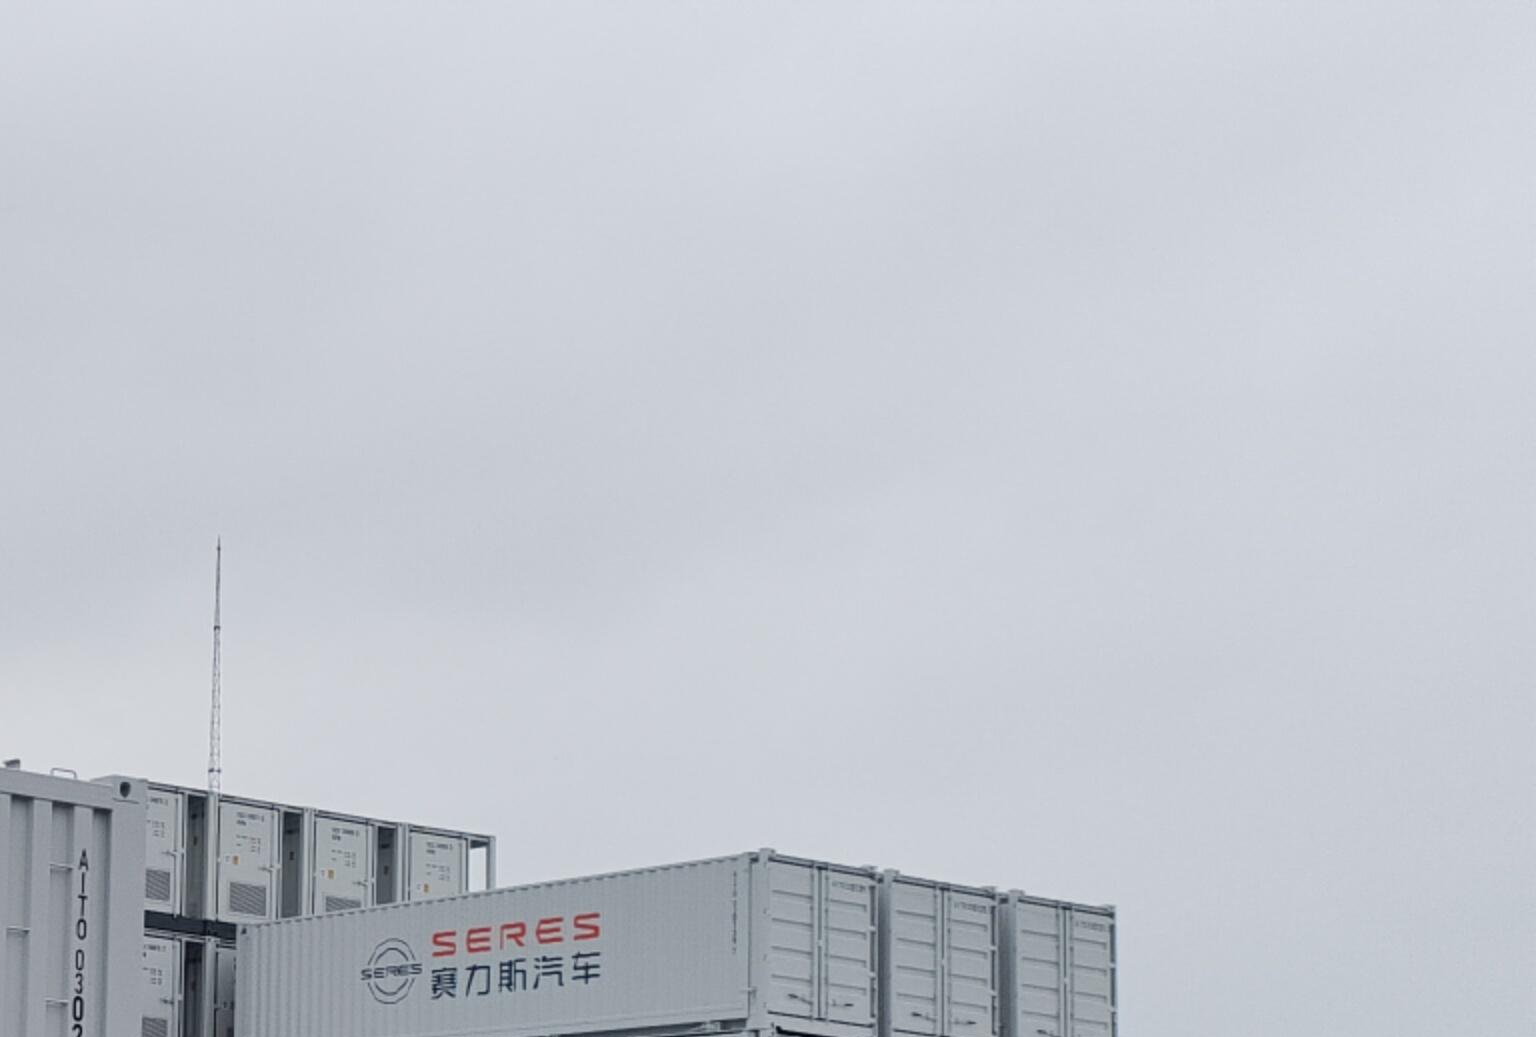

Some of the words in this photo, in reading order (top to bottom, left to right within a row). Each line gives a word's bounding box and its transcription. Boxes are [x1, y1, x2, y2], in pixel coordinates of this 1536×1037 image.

[432, 912, 601, 957] SERES
[361, 963, 423, 981] SERES
[431, 951, 601, 1000] 赛力斯汽车
